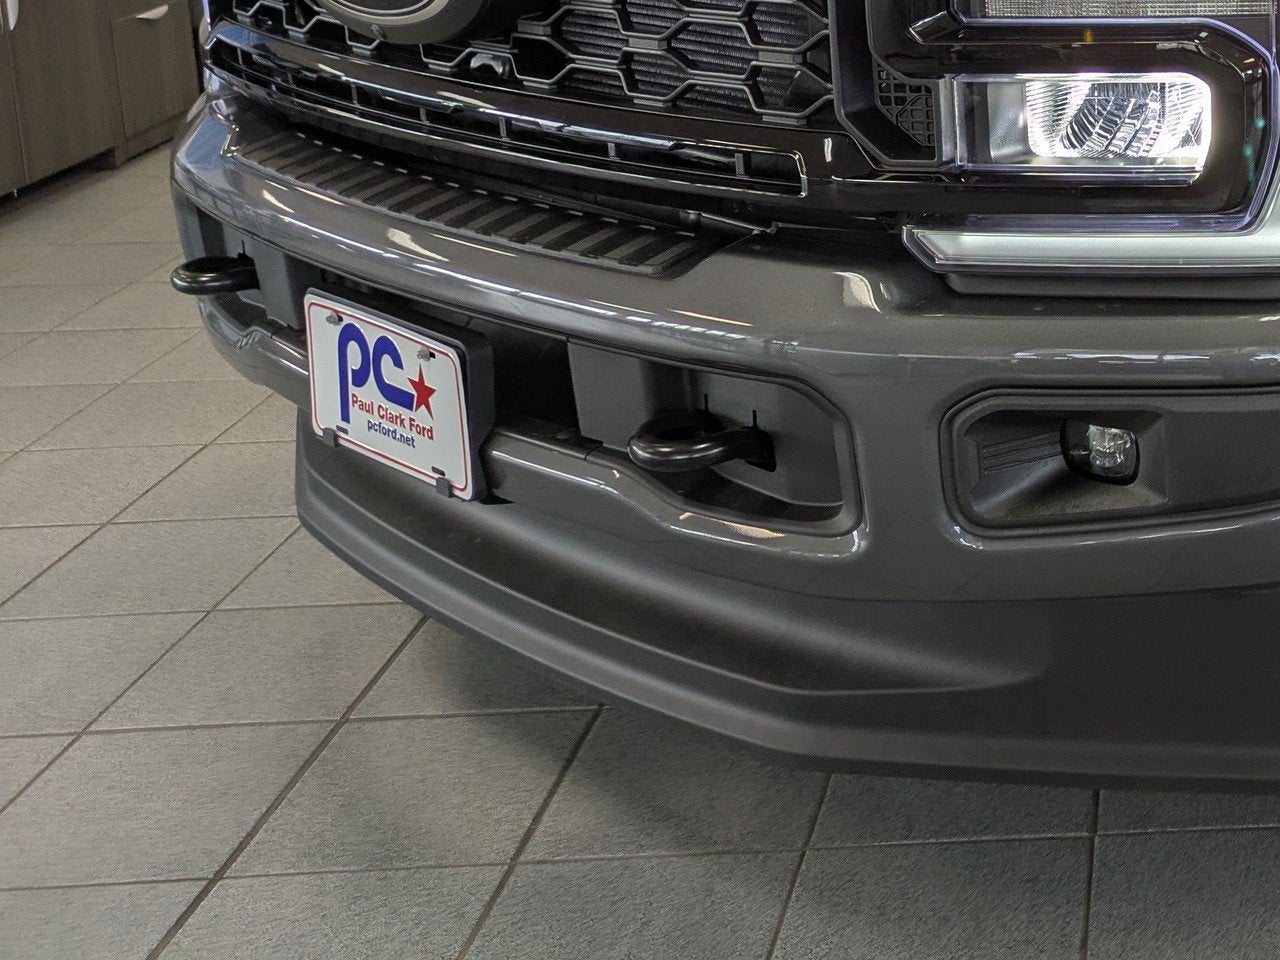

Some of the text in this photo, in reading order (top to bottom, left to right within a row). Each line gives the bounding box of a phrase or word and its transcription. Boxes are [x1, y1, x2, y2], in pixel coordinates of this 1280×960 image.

[351, 393, 434, 441] Paul Clark Ford
[367, 419, 416, 449] pcford.net
